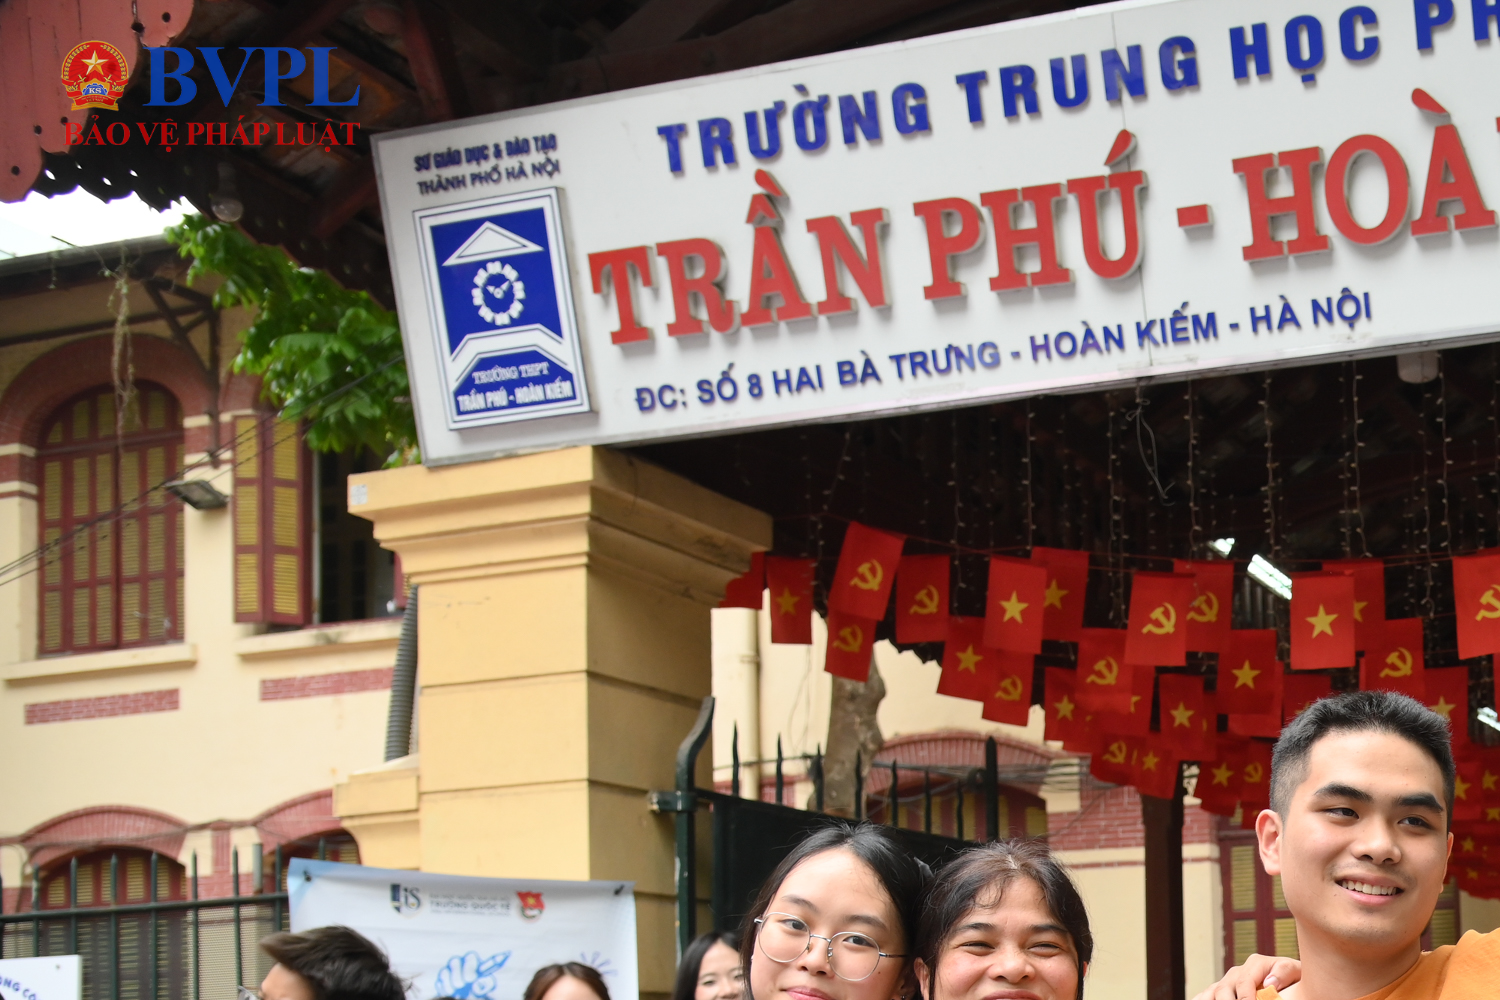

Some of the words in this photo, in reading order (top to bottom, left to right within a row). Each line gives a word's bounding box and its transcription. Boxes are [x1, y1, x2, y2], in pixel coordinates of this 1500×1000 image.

[657, 84, 932, 175] TRƯỜNG
[956, 36, 1199, 125] TRUNG
[1229, 5, 1381, 84] HỌC
[417, 174, 467, 196] THÀNH
[470, 163, 502, 187] PHỐ
[505, 160, 529, 181] HÀ
[532, 155, 561, 178] NỘI
[588, 168, 894, 347] TRẦN
[913, 129, 1149, 302] PHÚ
[635, 382, 688, 413] ĐC:
[696, 361, 743, 406] SỐ
[748, 372, 764, 400] 8
[771, 365, 825, 397] HAI
[835, 352, 881, 387] BÀ
[890, 339, 1001, 382] TRƯNG
[1029, 320, 1126, 363] HOÀN
[1137, 300, 1218, 349] KIẾM
[1251, 294, 1302, 333] HÀ
[1312, 287, 1374, 331] NỘI
